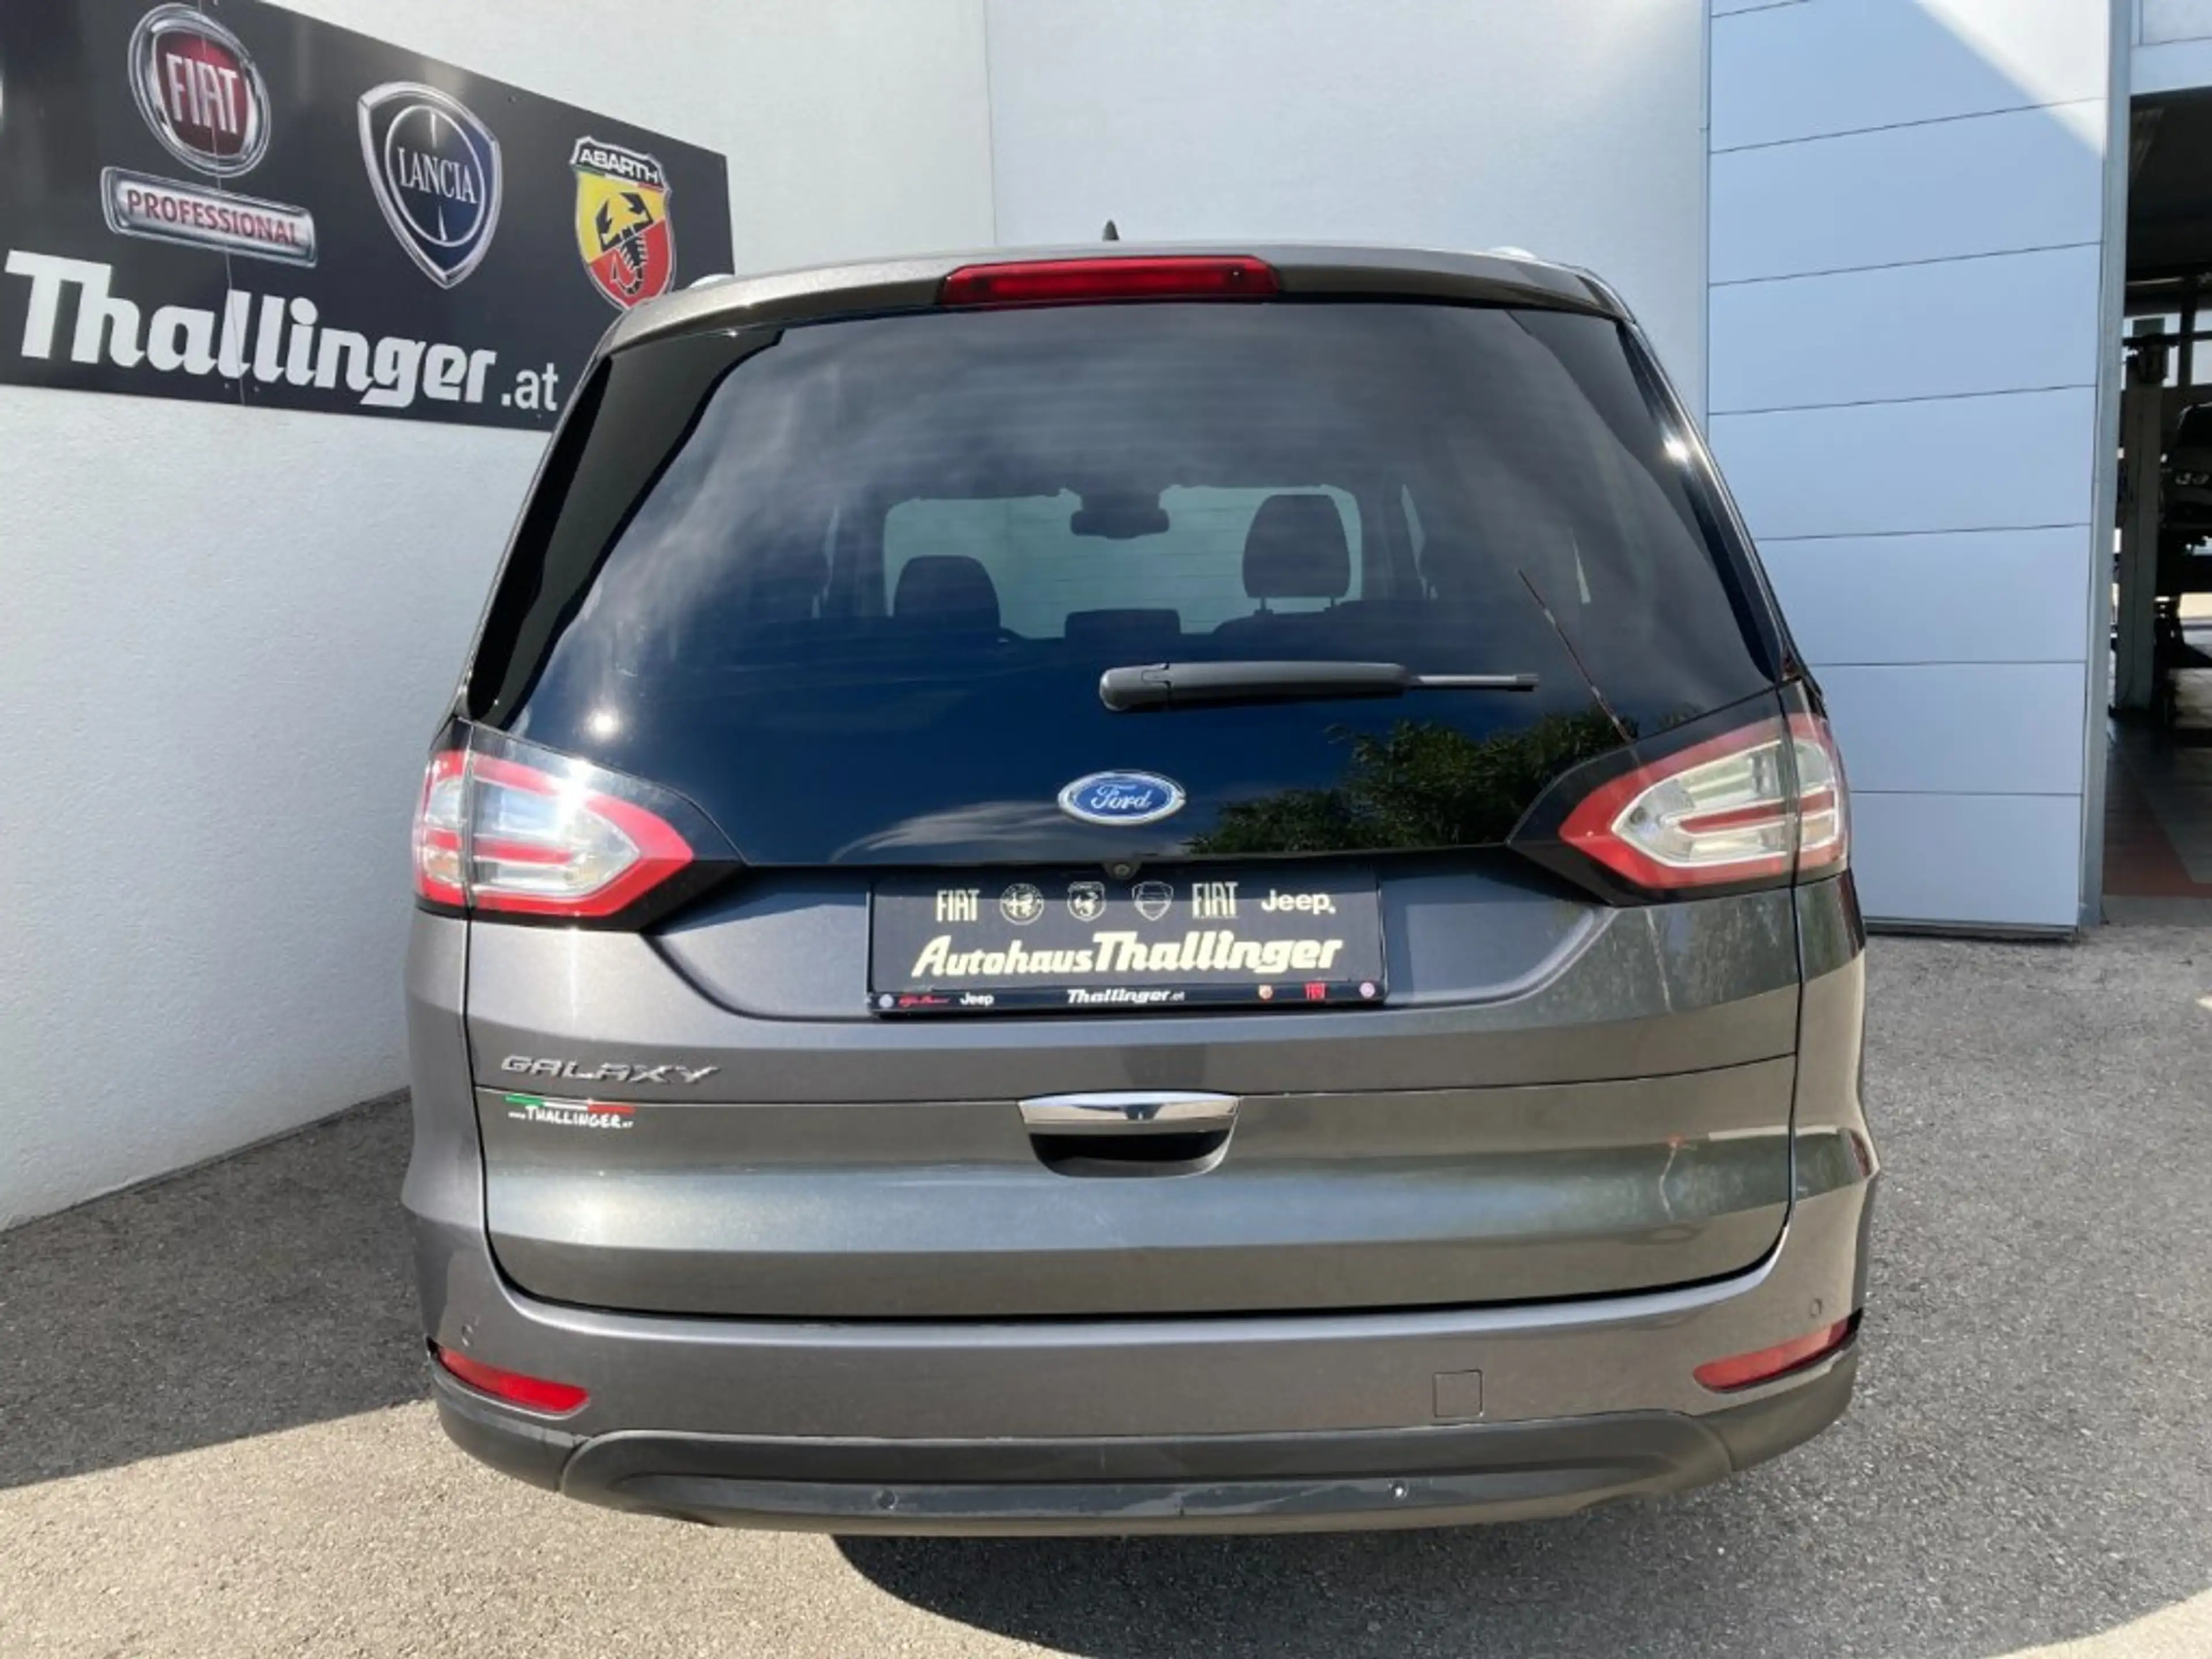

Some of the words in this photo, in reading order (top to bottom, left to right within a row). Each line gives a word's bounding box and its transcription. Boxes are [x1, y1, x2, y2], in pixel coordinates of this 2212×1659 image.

[166, 52, 238, 135] FIAT
[397, 146, 478, 204] LANCIA
[579, 149, 659, 184] ABARTH
[127, 188, 302, 247] PROFESSIONAL
[1090, 783, 1152, 809] Ford
[936, 888, 980, 922] FIAT
[1192, 881, 1238, 916] FIAT
[959, 991, 994, 1006] Jeep
[501, 1054, 721, 1084] GALAXY
